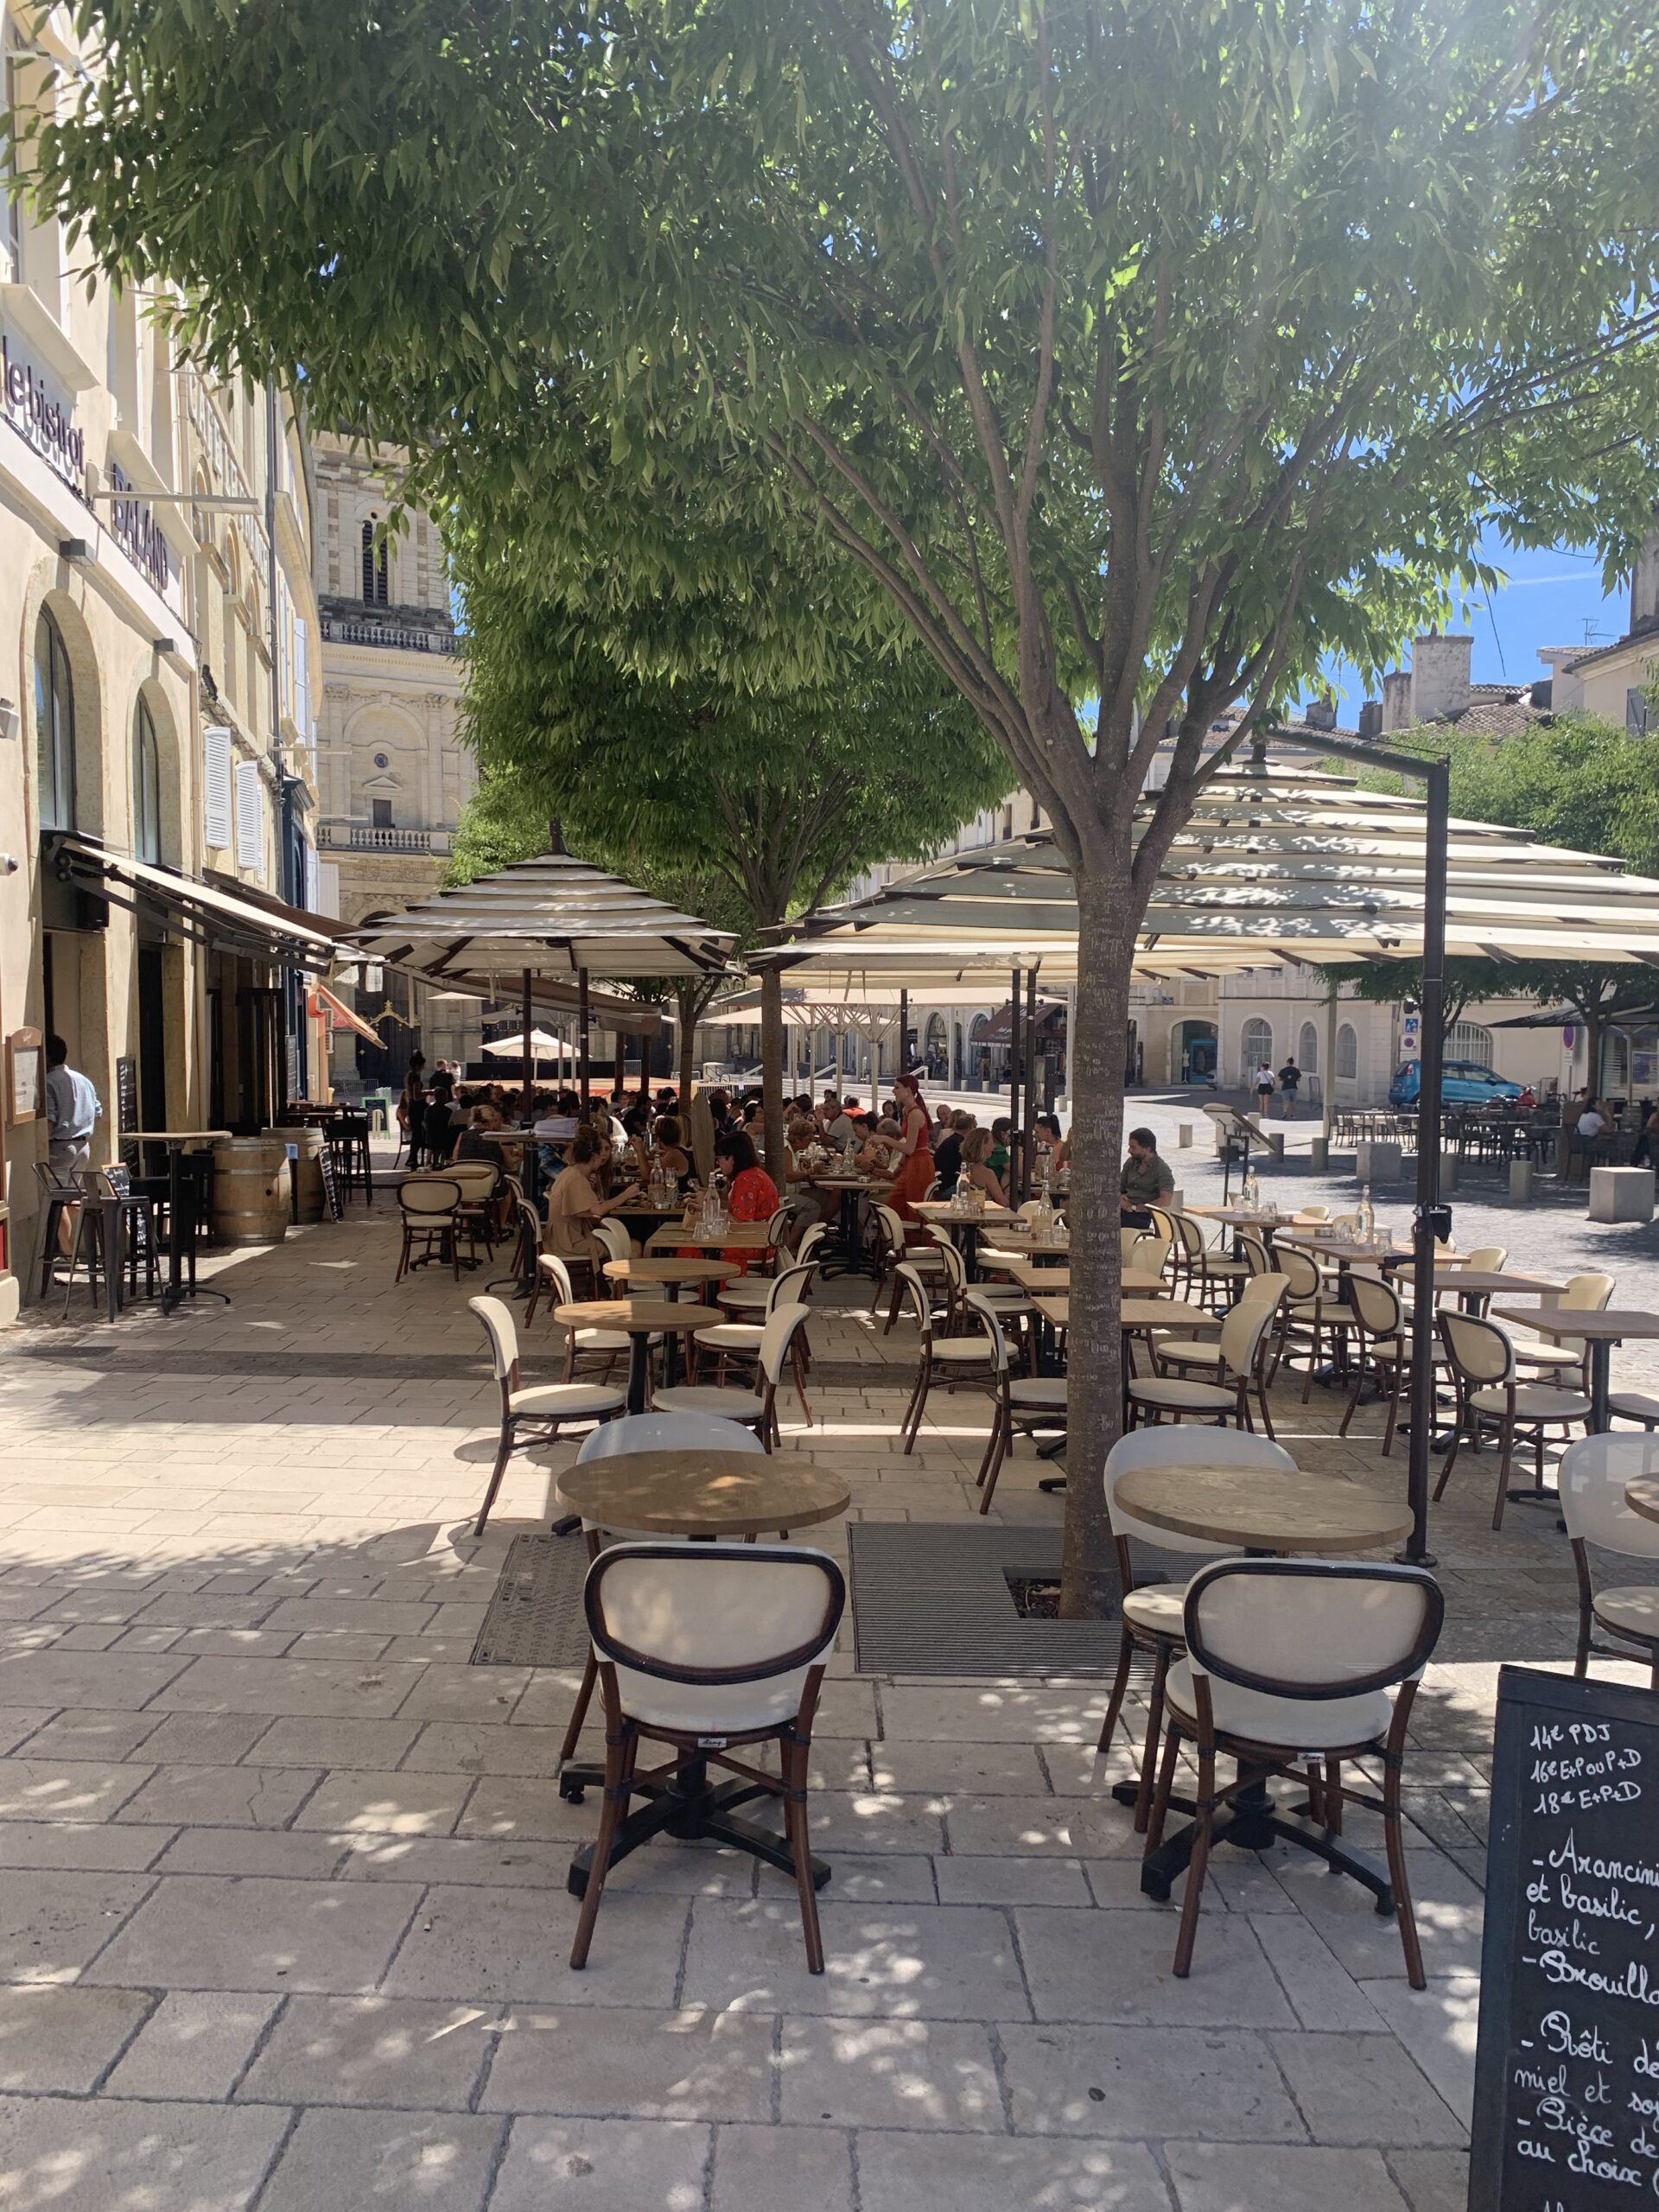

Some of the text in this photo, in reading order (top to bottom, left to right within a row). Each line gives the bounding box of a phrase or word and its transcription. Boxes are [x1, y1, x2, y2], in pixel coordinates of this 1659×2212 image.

[1529, 1723, 1611, 1751] 14€ PDJ
[1526, 1873, 1551, 1903] et
[1529, 1908, 1600, 1955] basilic
[1540, 2010, 1613, 2064] Rôti
[1514, 2064, 1572, 2097] miel
[1585, 2070, 1611, 2104] et
[1536, 2097, 1615, 2147] Pièce
[1517, 2139, 1556, 2163] au
[1567, 2139, 1642, 2187] choix
